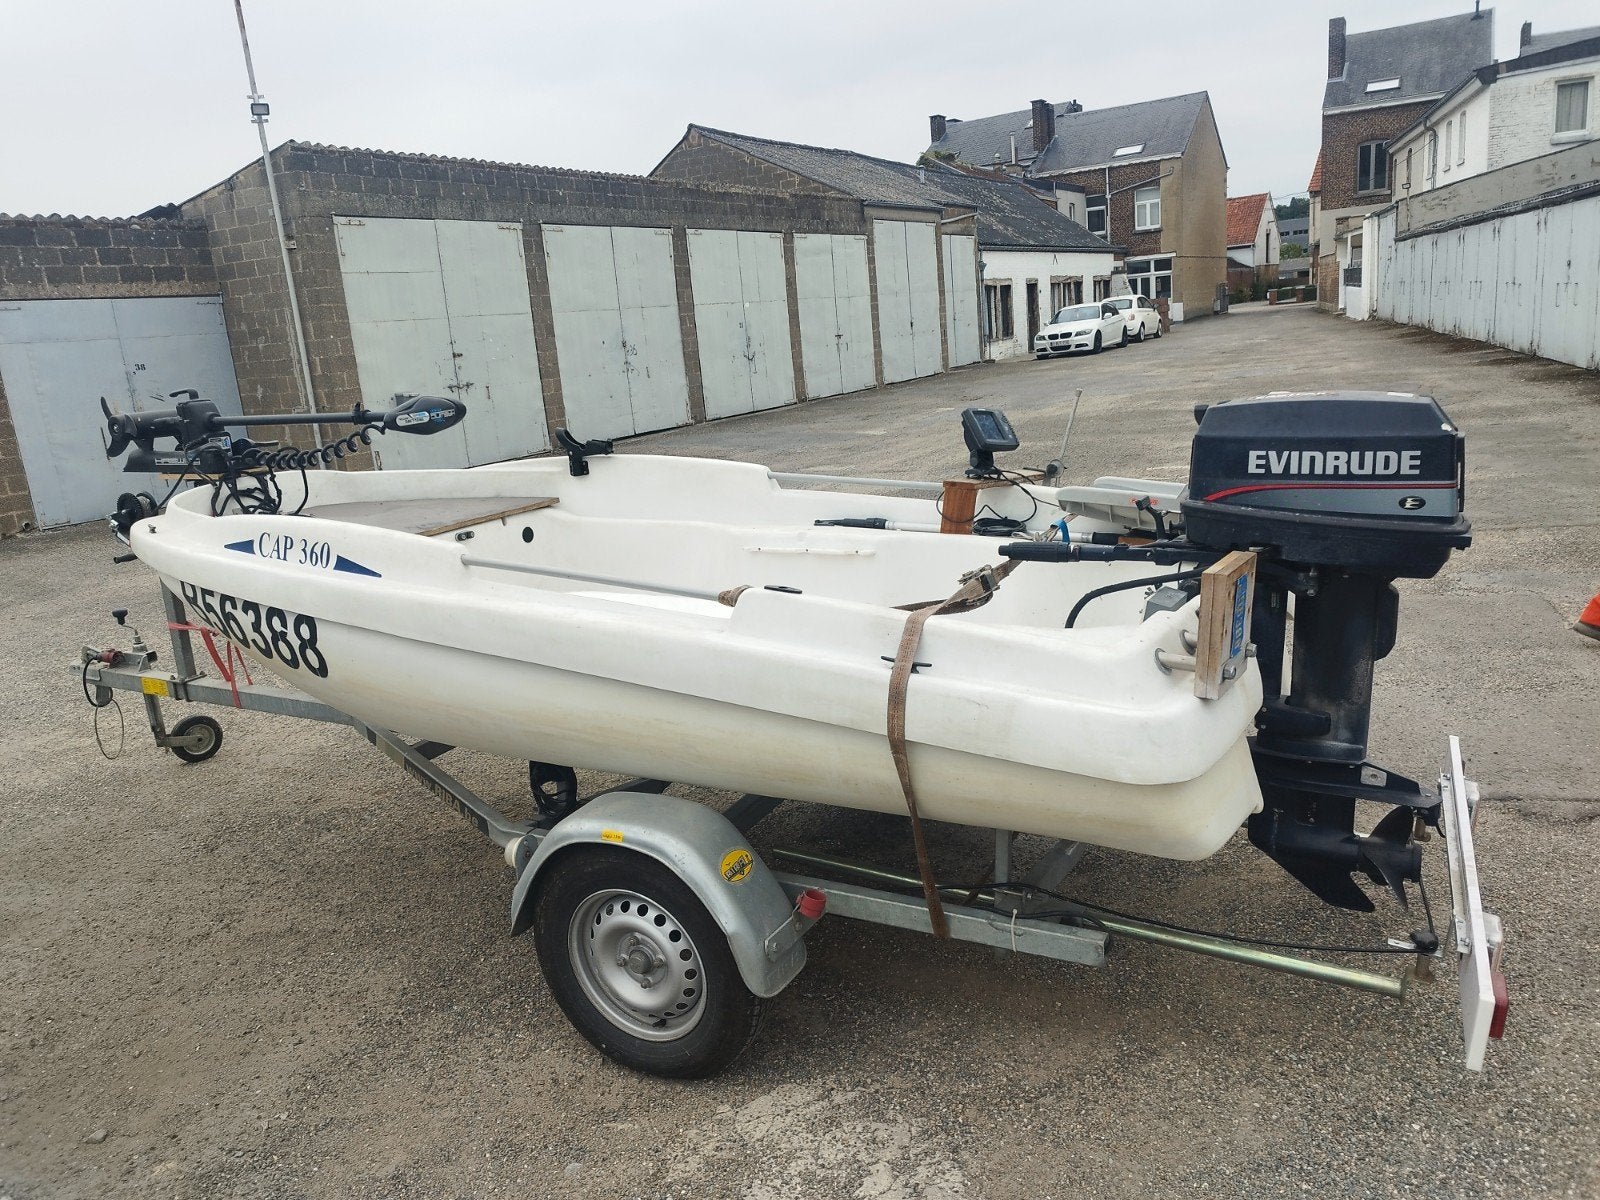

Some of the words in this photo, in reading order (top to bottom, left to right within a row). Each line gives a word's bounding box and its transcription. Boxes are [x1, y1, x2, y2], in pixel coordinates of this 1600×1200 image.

[1248, 450, 1421, 475] EVINRUDE
[258, 531, 294, 562] CAP
[298, 538, 331, 569] 360
